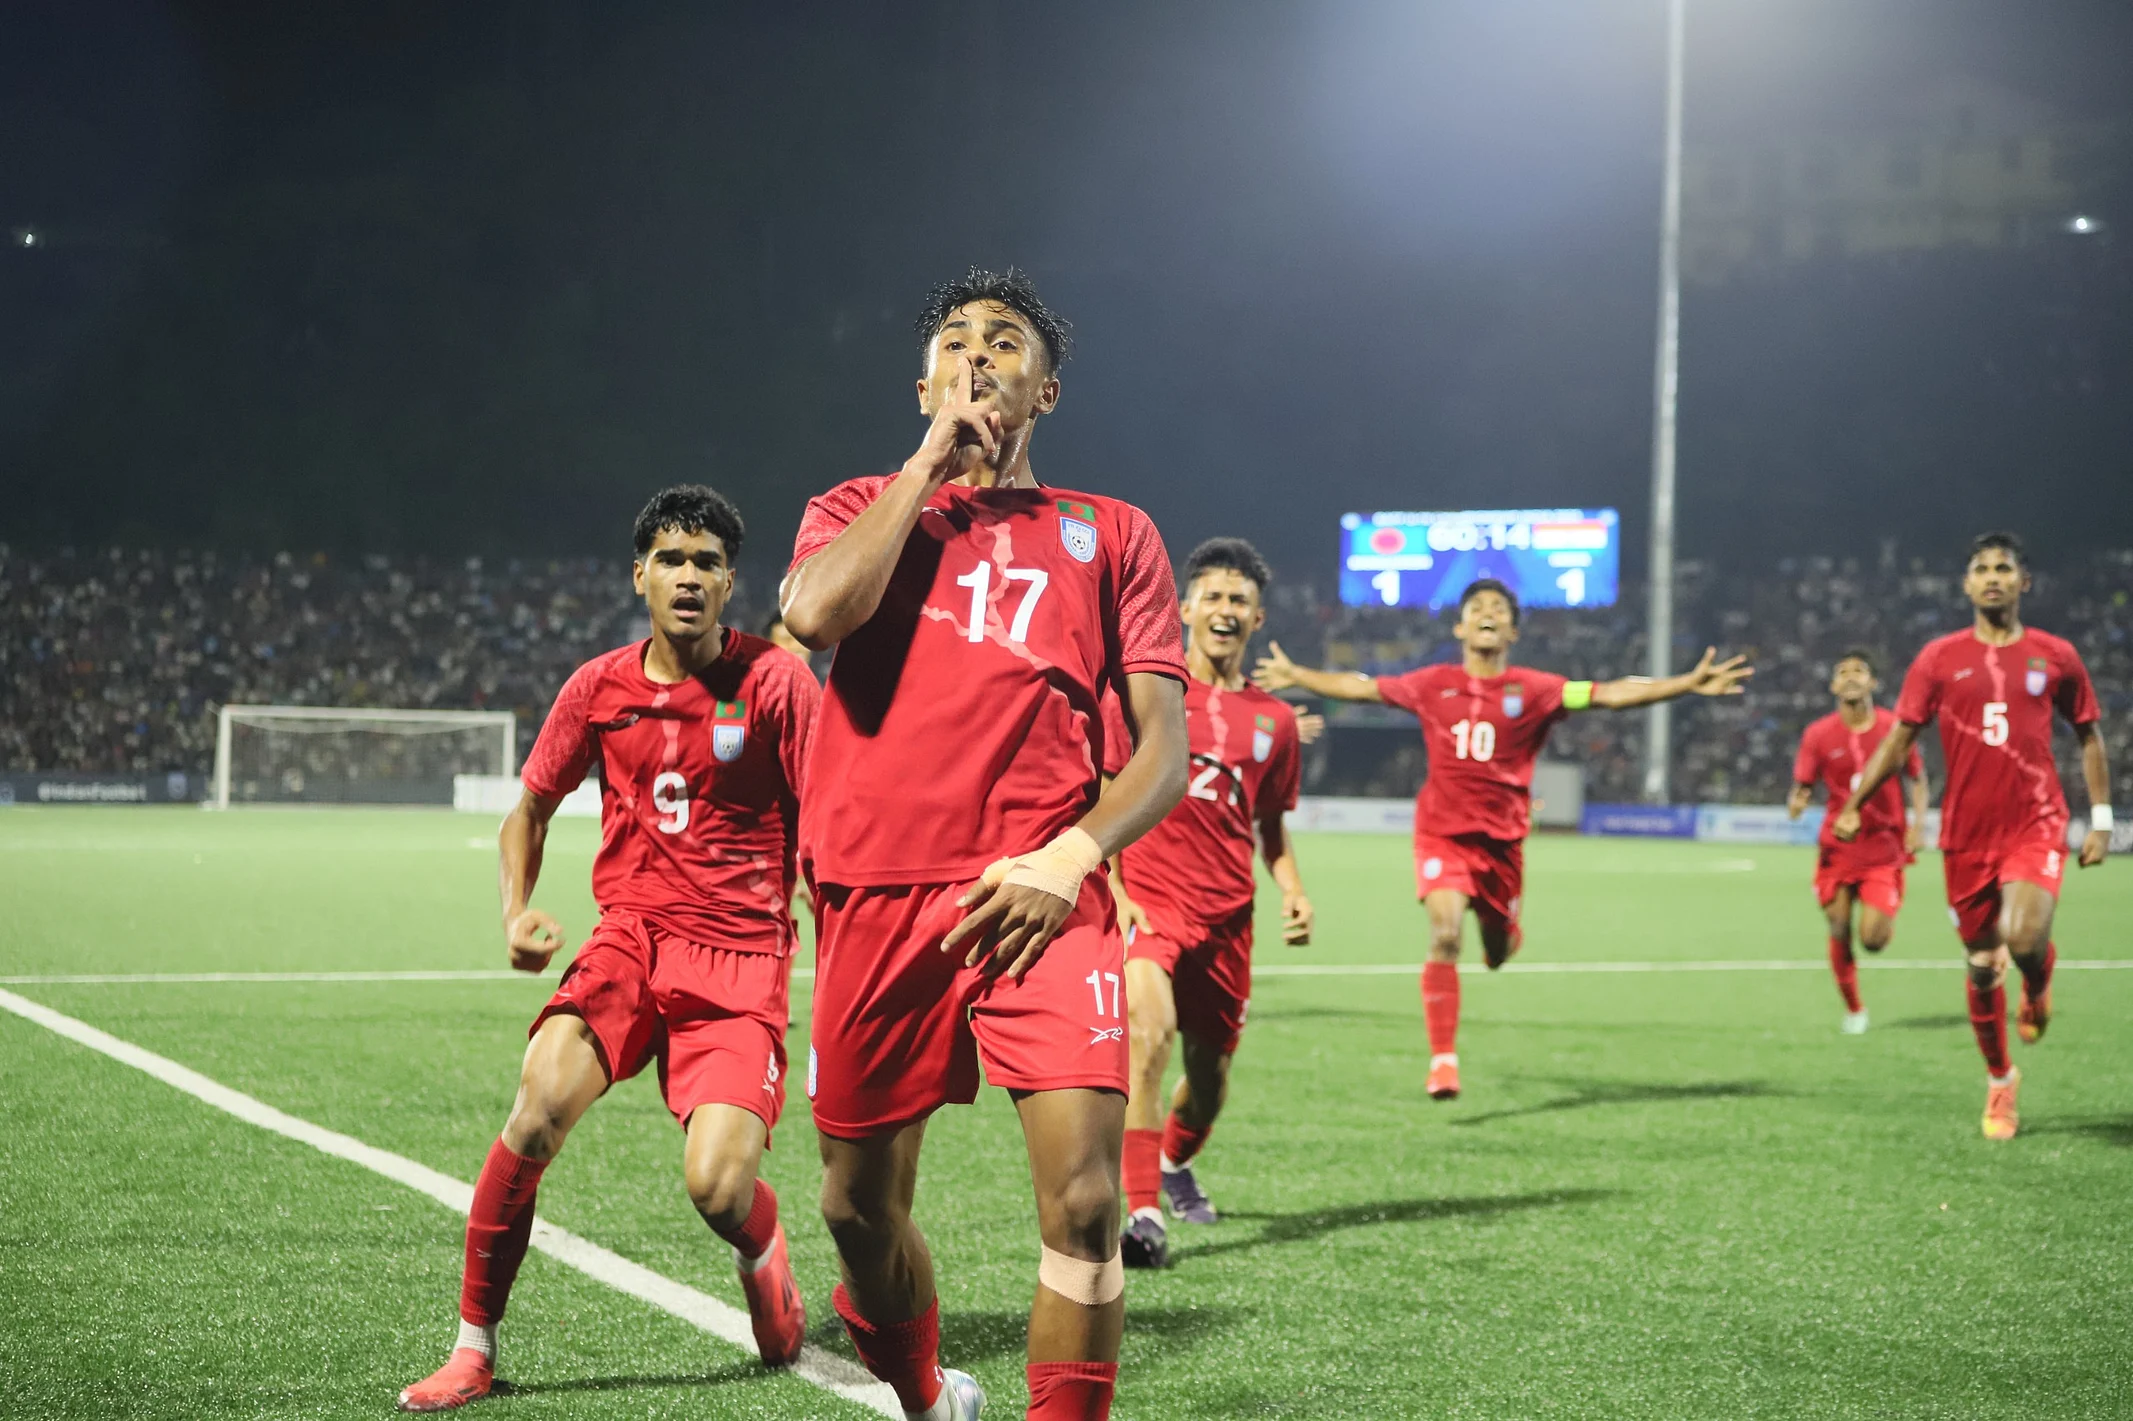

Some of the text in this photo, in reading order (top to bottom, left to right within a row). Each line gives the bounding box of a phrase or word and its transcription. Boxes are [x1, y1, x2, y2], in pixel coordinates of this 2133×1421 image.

[957, 560, 1049, 643] 17
[1371, 569, 1400, 606] 1
[1556, 568, 1585, 606] 1
[1450, 718, 1496, 762] 10
[1982, 702, 2009, 746] 5
[653, 771, 689, 834] 9
[1187, 752, 1243, 806] 21
[1086, 969, 1119, 1019] 17
